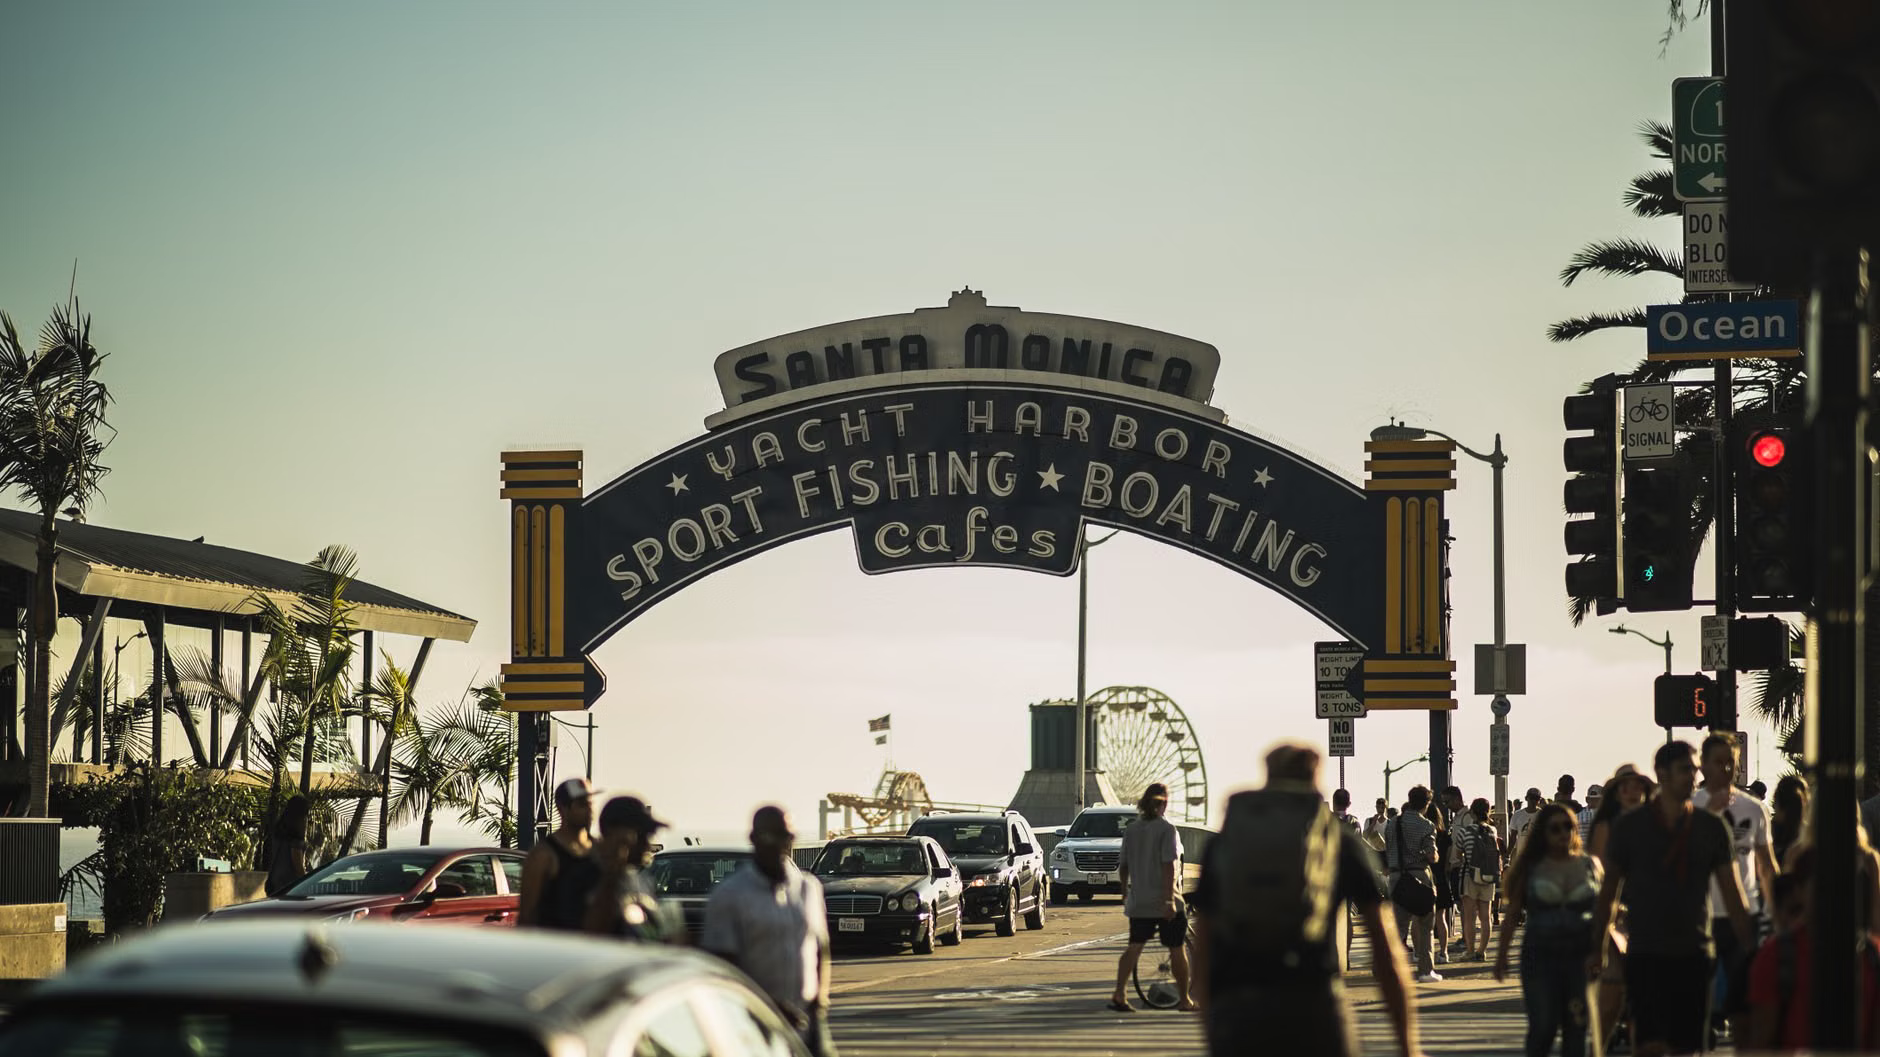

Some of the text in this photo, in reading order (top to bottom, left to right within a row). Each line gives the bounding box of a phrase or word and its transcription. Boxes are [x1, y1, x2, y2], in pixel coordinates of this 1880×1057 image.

[1715, 100, 1724, 127] 1
[1681, 143, 1728, 164] NOR
[1689, 213, 1713, 234] DO
[1689, 242, 1726, 264] BLO
[1688, 269, 1731, 284] INTERSE
[1659, 311, 1786, 341] Ocean
[734, 323, 1193, 402] SANTA MONICA
[706, 400, 1232, 480] YACHT HARBOR
[1628, 431, 1671, 448] SIGNAL
[606, 451, 1328, 601] SPORT FISHING BOATING
[1320, 666, 1351, 677] 10 TO
[1321, 702, 1361, 713] 3 TONS
[1694, 687, 1707, 718] 6
[1333, 721, 1350, 734] NO
